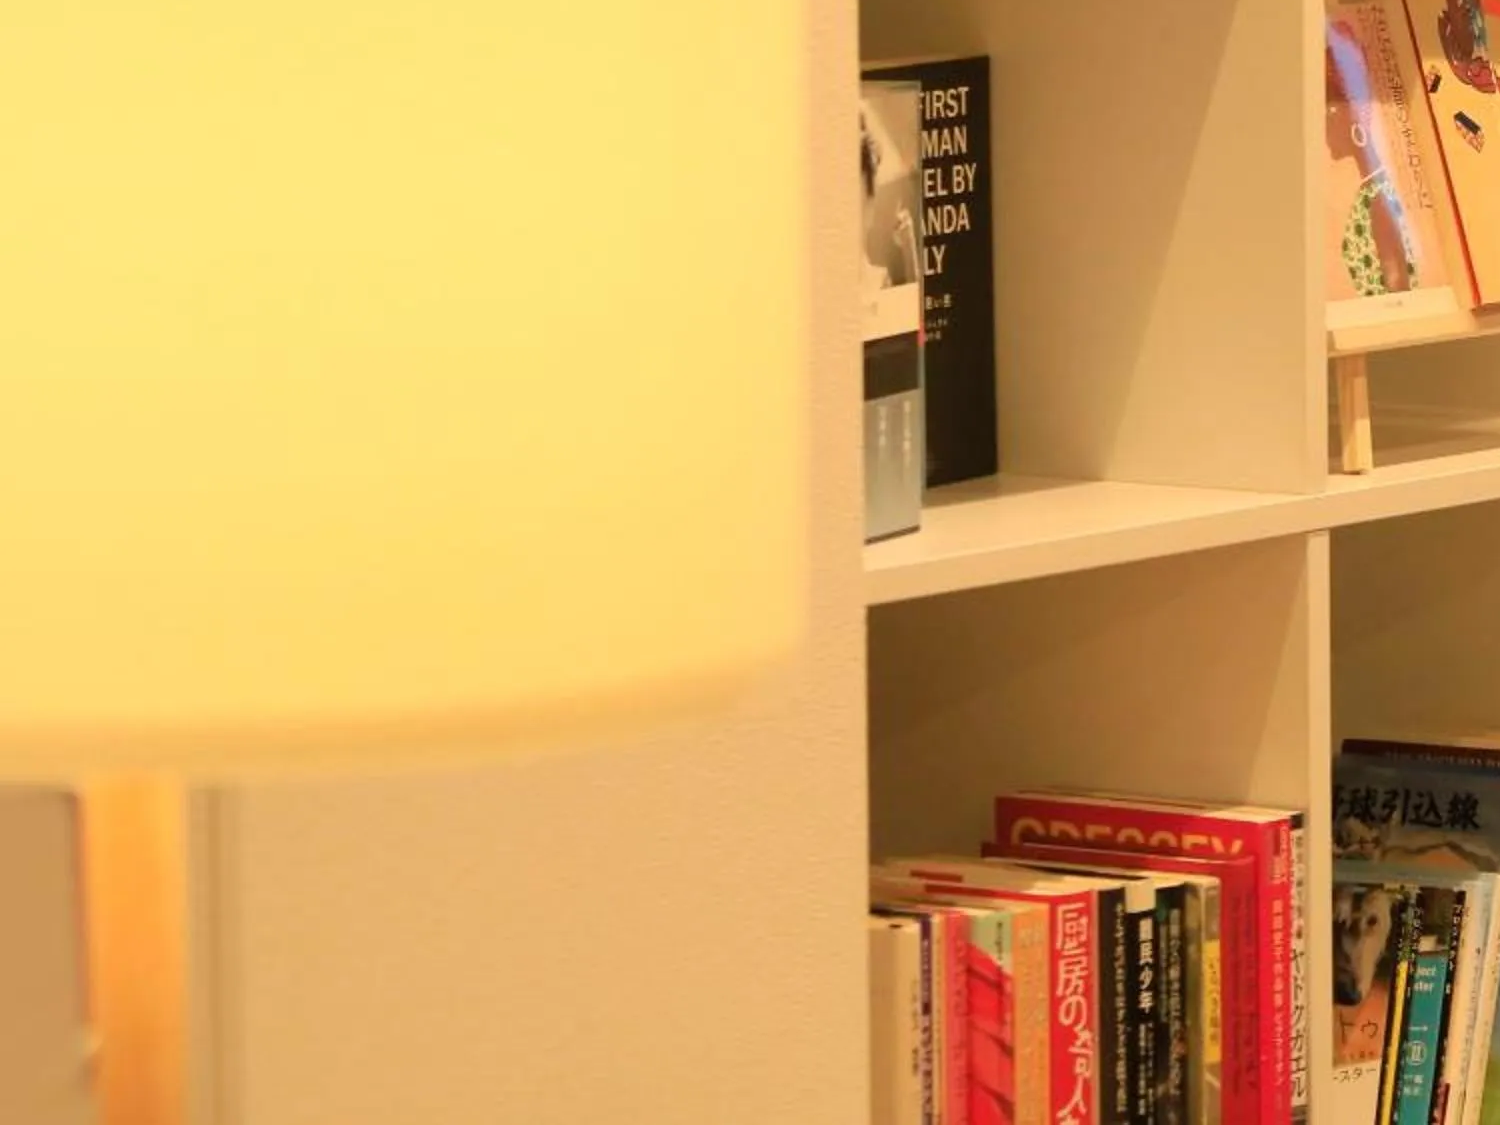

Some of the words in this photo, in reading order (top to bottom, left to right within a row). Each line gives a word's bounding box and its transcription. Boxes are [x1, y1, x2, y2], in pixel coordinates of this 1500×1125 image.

[921, 125, 968, 159] MAN
[952, 162, 978, 196] BY
[1056, 900, 1094, 1125] 厨房の奇人
